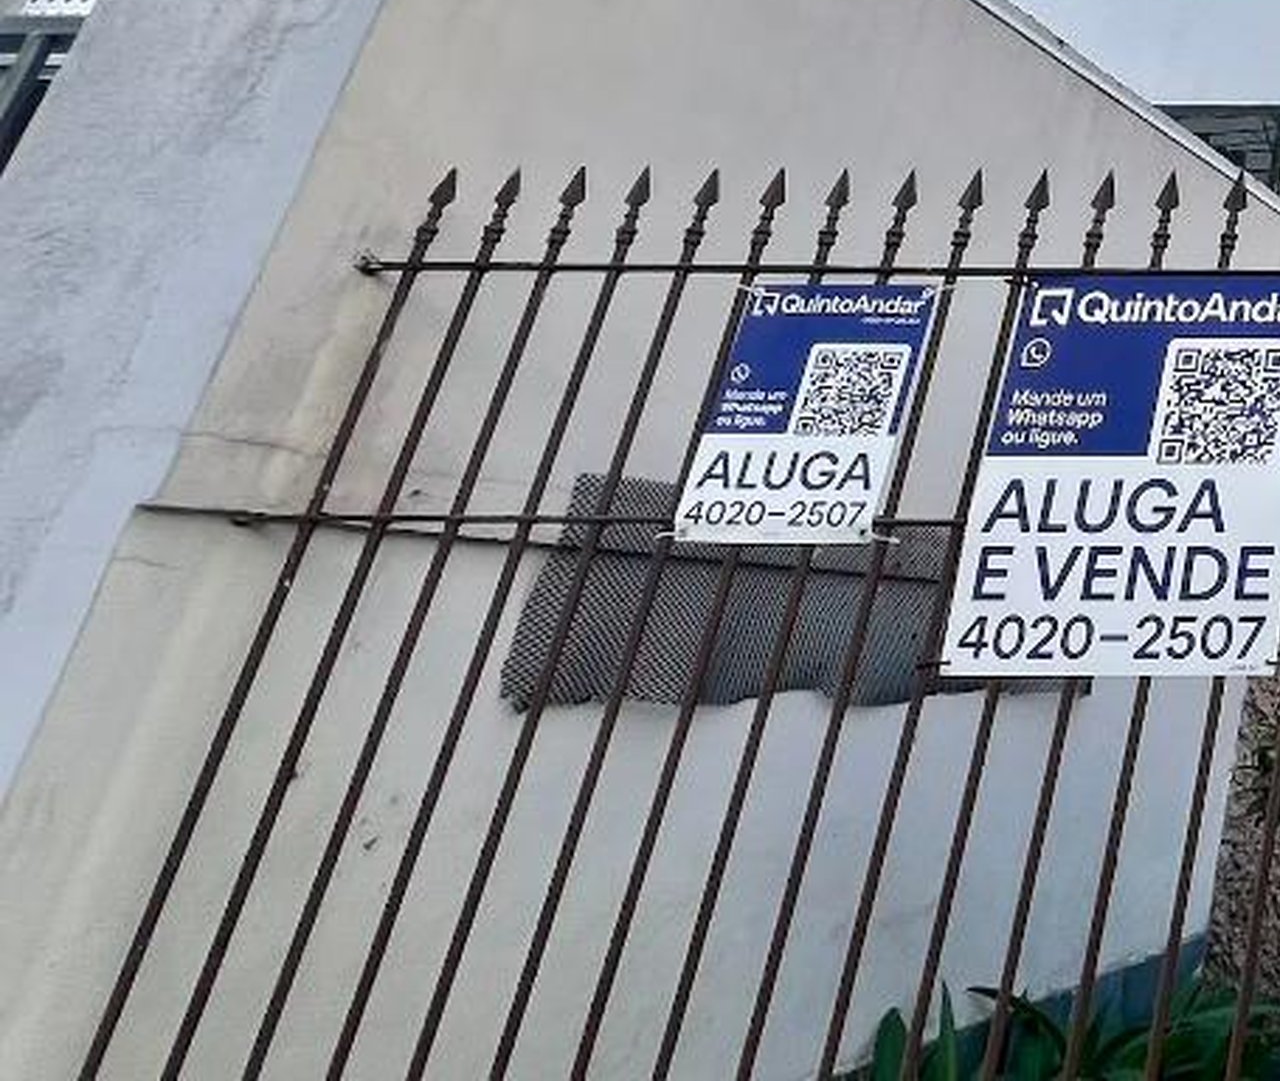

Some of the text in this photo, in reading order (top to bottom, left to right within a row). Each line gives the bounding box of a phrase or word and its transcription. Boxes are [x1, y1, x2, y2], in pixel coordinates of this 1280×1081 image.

[780, 293, 924, 315] QuintoAndar
[1011, 389, 1107, 406] Mande um
[1008, 408, 1104, 428] Whatsapp
[1001, 429, 1079, 449] ou ligue.
[696, 450, 871, 490] ALUGA
[684, 500, 867, 527] 4020-2507
[981, 478, 1225, 533] ALUGA
[971, 546, 1275, 600] E VENDE
[957, 614, 1267, 660] 4020-2507
